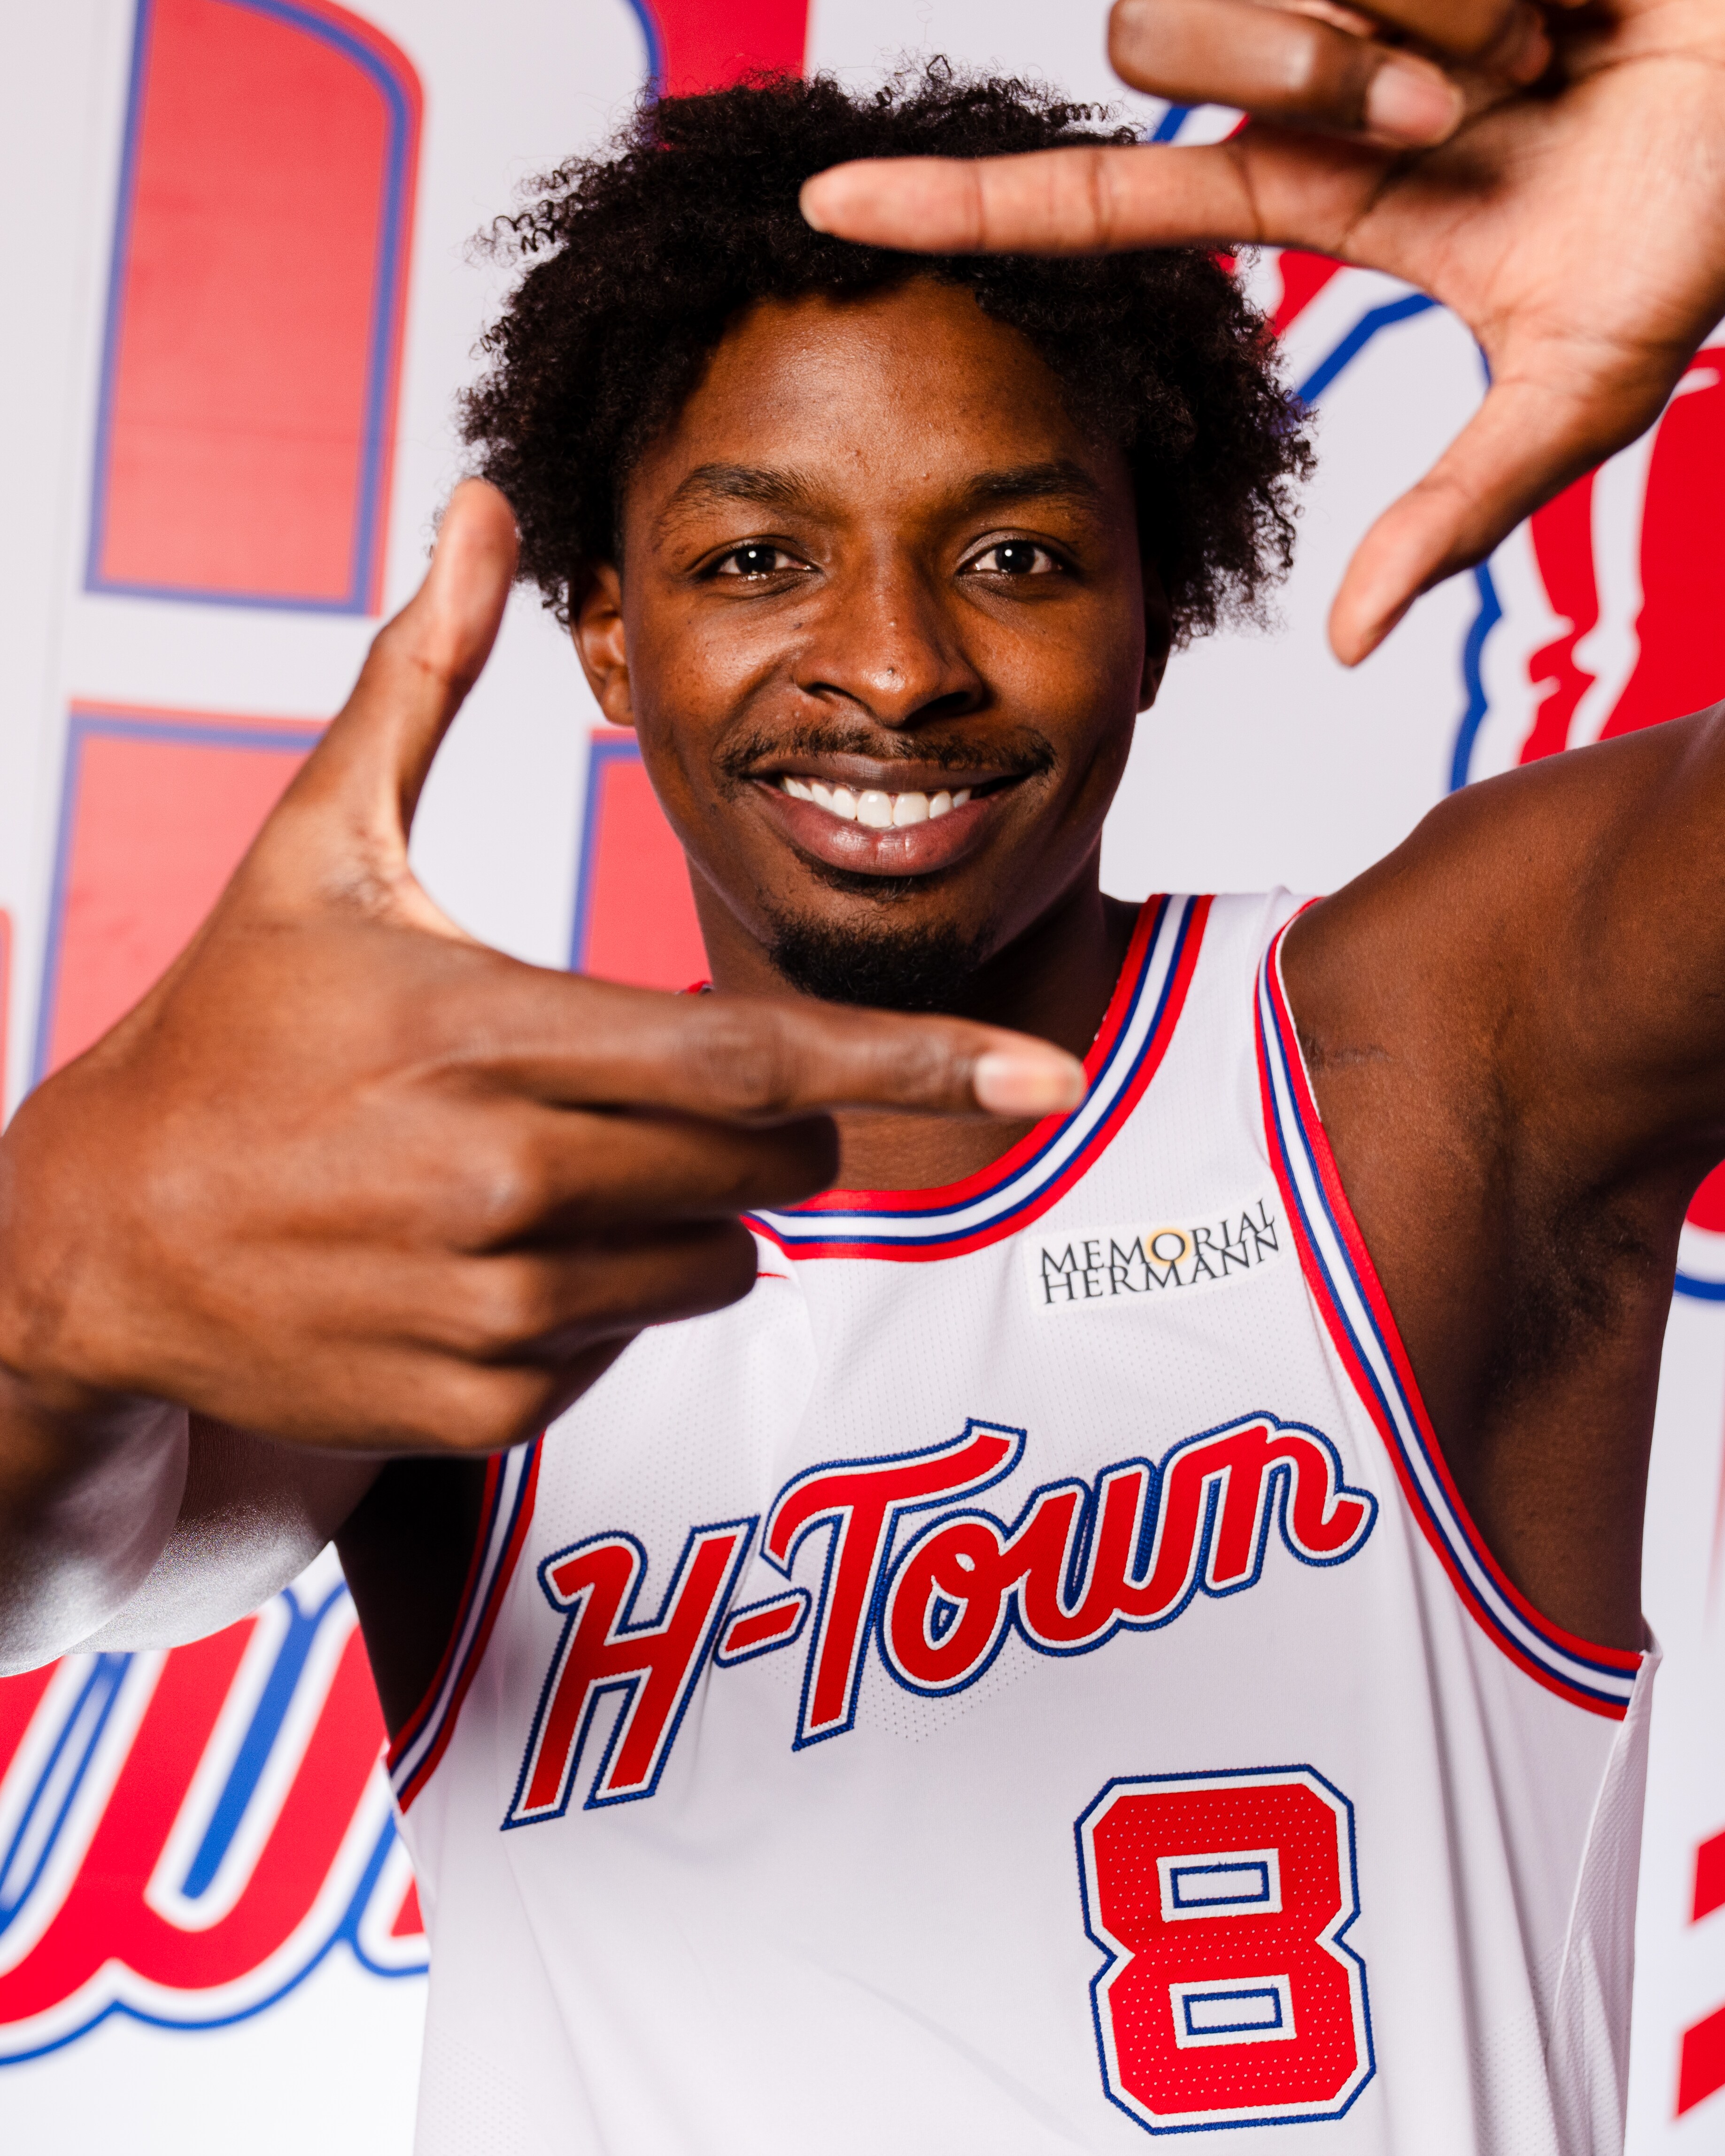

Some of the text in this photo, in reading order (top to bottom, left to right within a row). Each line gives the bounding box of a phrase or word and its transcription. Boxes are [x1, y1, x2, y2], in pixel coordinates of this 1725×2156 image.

[1039, 1198, 1275, 1276] MEMORIAL
[1042, 1223, 1279, 1304] HERMANN
[500, 1411, 1378, 1831] H-Town
[1074, 1763, 1377, 2136] 8
